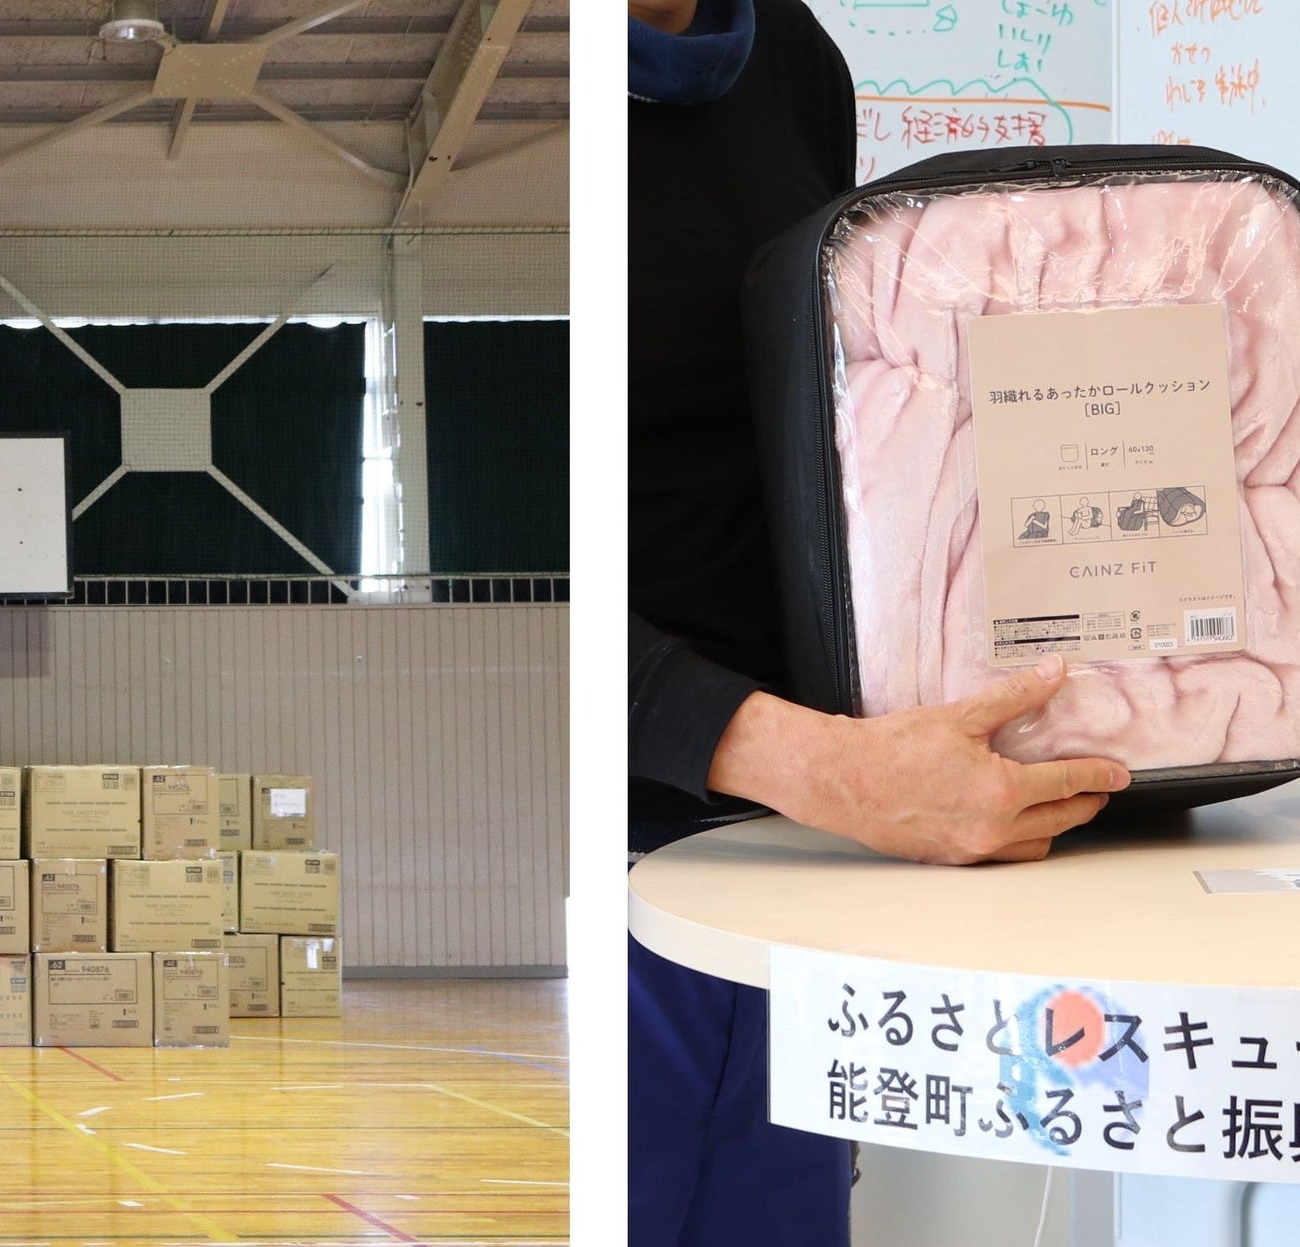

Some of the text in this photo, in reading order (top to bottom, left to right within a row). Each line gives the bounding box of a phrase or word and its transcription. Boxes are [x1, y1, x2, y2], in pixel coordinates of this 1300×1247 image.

[989, 378, 1211, 405] 羽織れるあったかロールクッション
[1084, 401, 1121, 417] [BIG]
[1090, 445, 1118, 456] ロング
[1069, 563, 1124, 579] CAINZ
[81, 965, 110, 973] 940876
